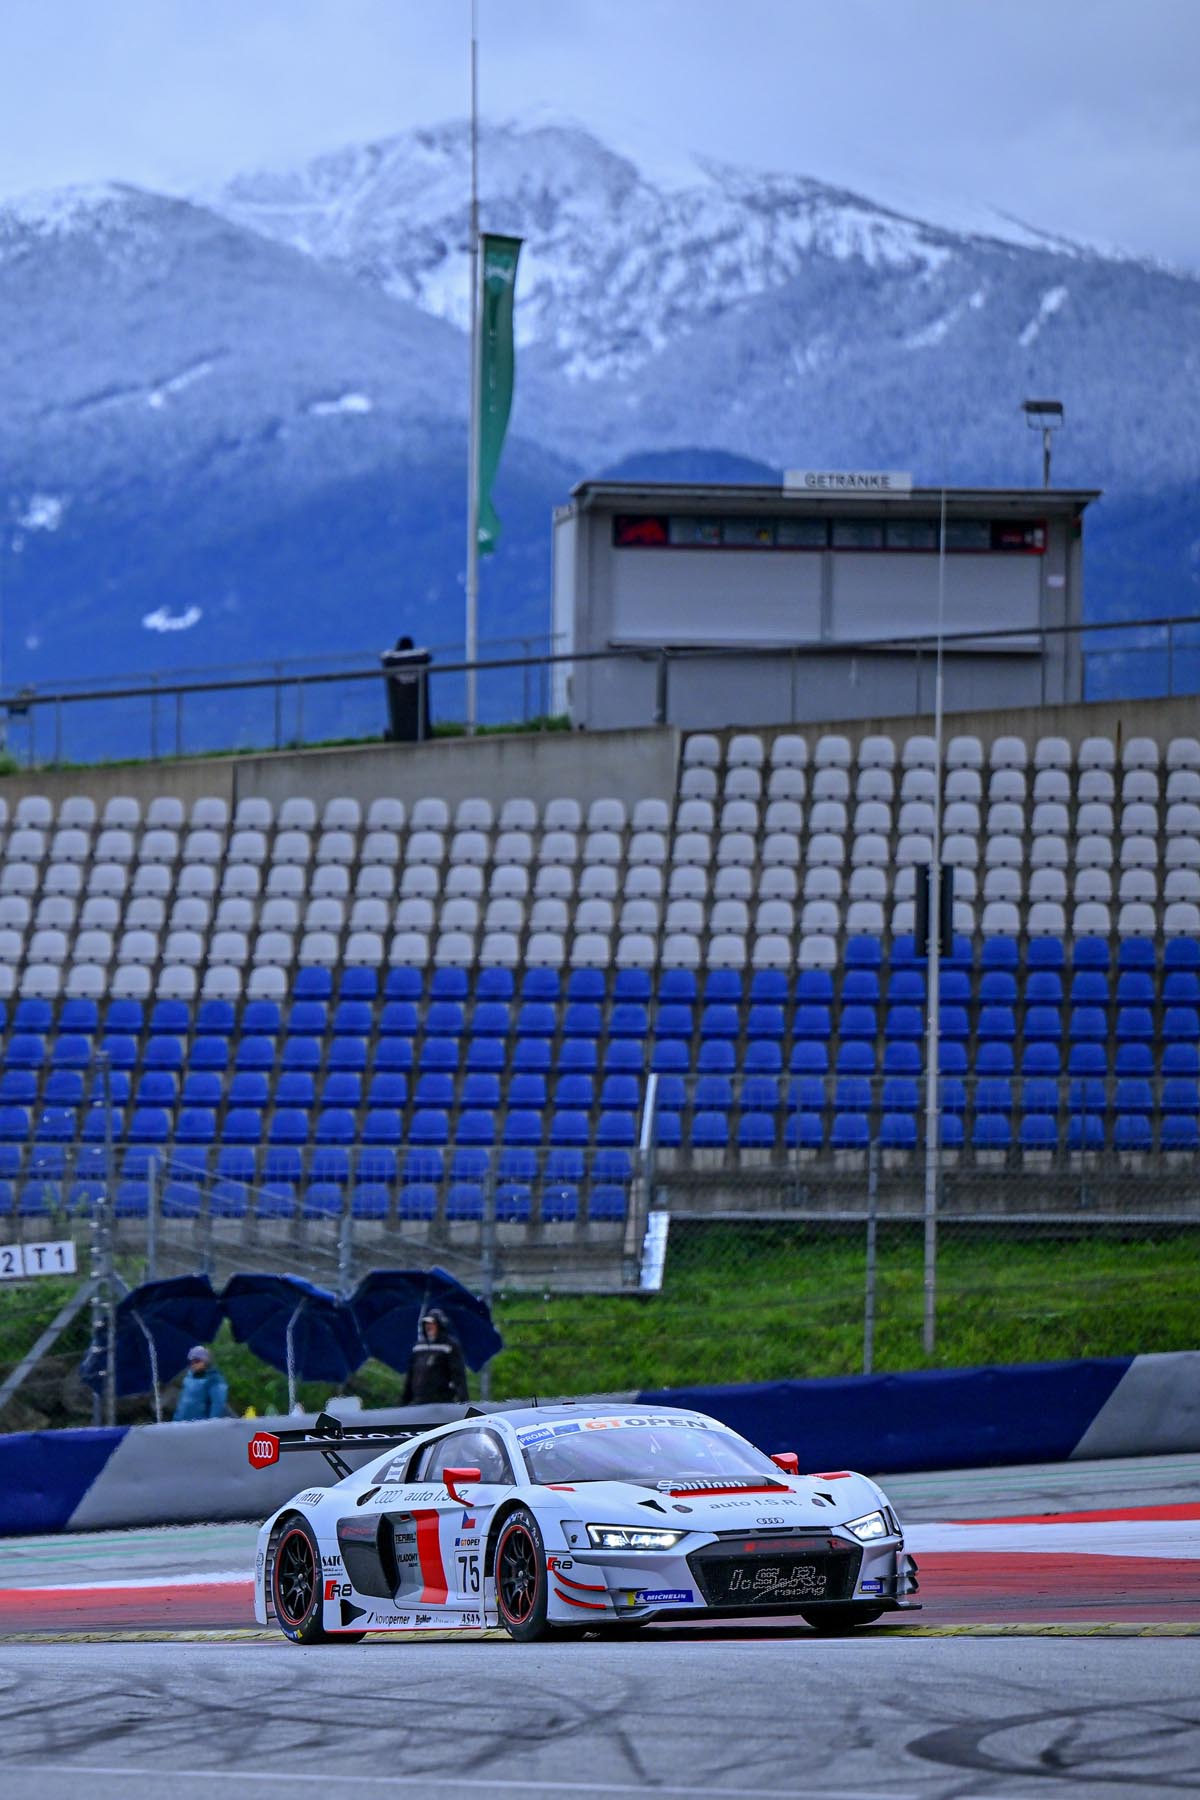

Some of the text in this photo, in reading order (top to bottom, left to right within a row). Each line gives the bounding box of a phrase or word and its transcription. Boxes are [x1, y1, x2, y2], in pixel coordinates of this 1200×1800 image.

[520, 1430, 551, 1444] PROAM
[535, 1441, 554, 1452] 75
[404, 1491, 433, 1502] auto
[709, 1501, 750, 1510] auto
[552, 1559, 573, 1570] R8
[458, 1555, 480, 1593] 75
[330, 1583, 352, 1598] R8
[646, 1593, 687, 1601] MICHELIN
